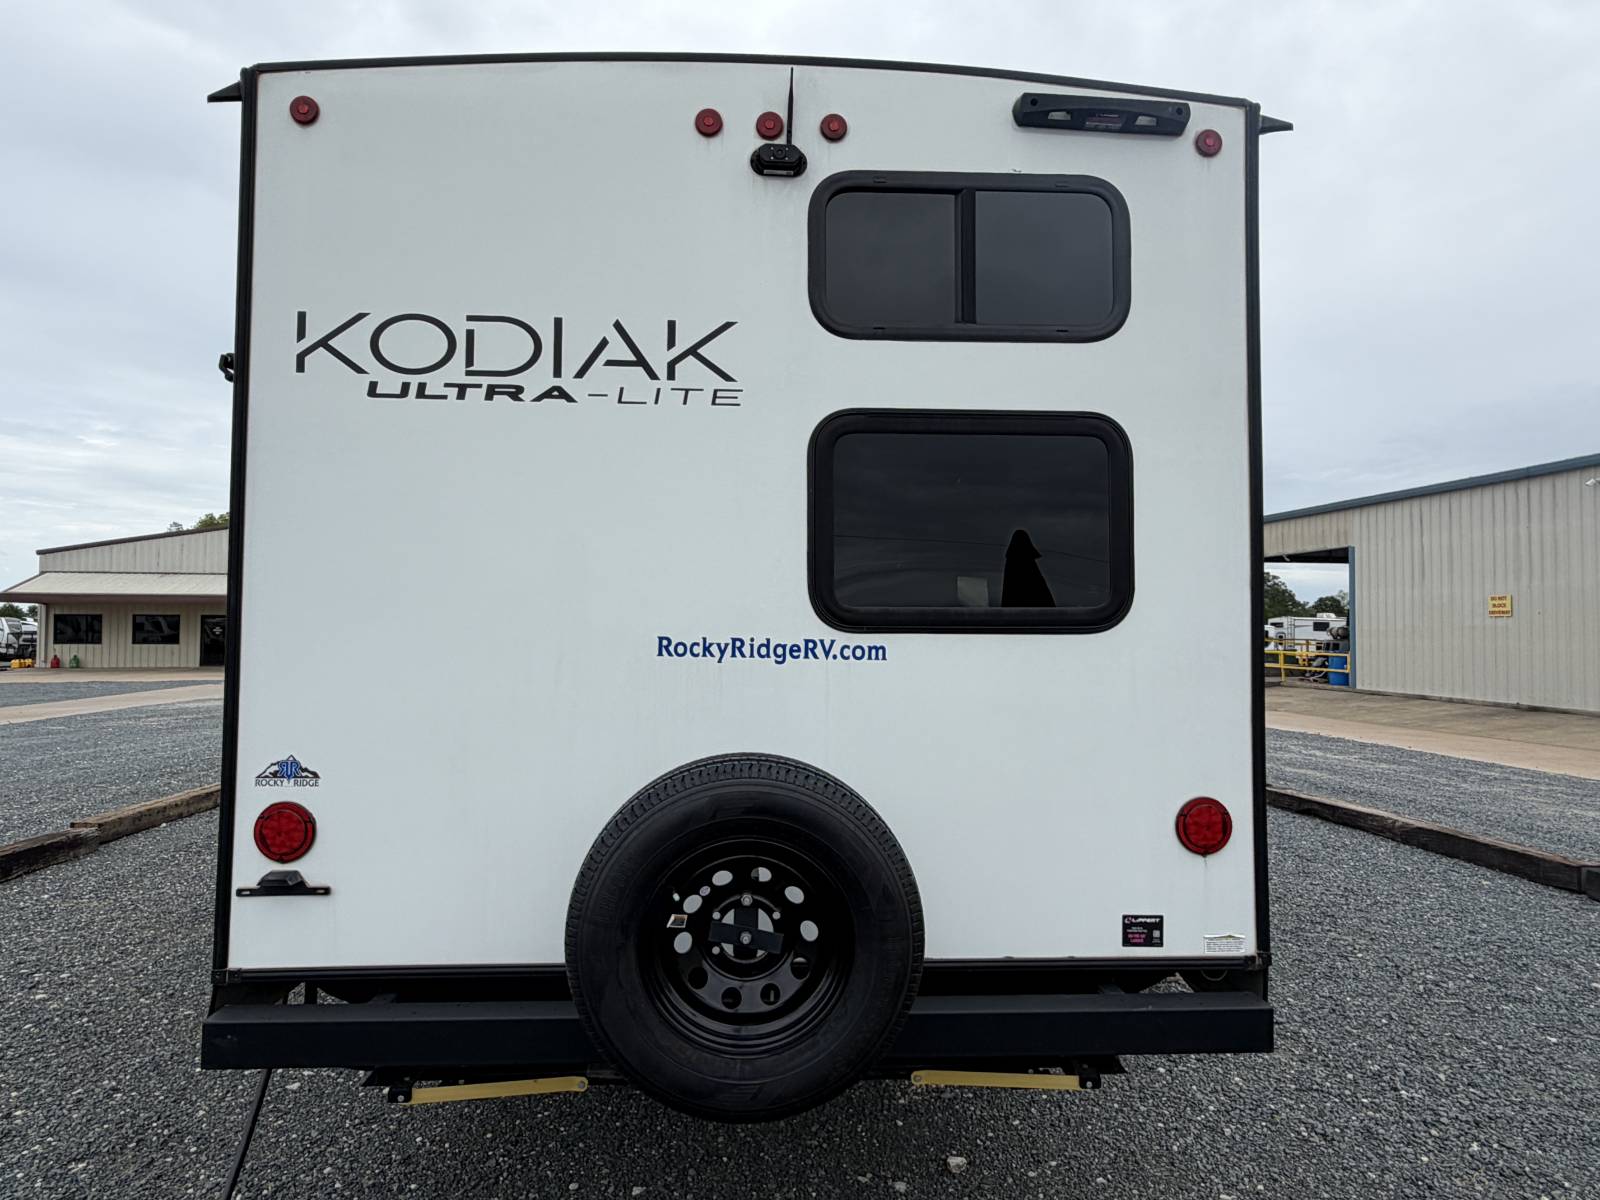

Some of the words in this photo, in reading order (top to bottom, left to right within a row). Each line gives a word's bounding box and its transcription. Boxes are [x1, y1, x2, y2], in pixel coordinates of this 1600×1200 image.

[295, 310, 739, 383] KODIAK
[366, 380, 744, 407] ULTRA-LITE
[656, 636, 888, 665] RockyRidgeRV.com
[255, 779, 284, 787] ROCKY
[293, 779, 319, 787] RIDGE
